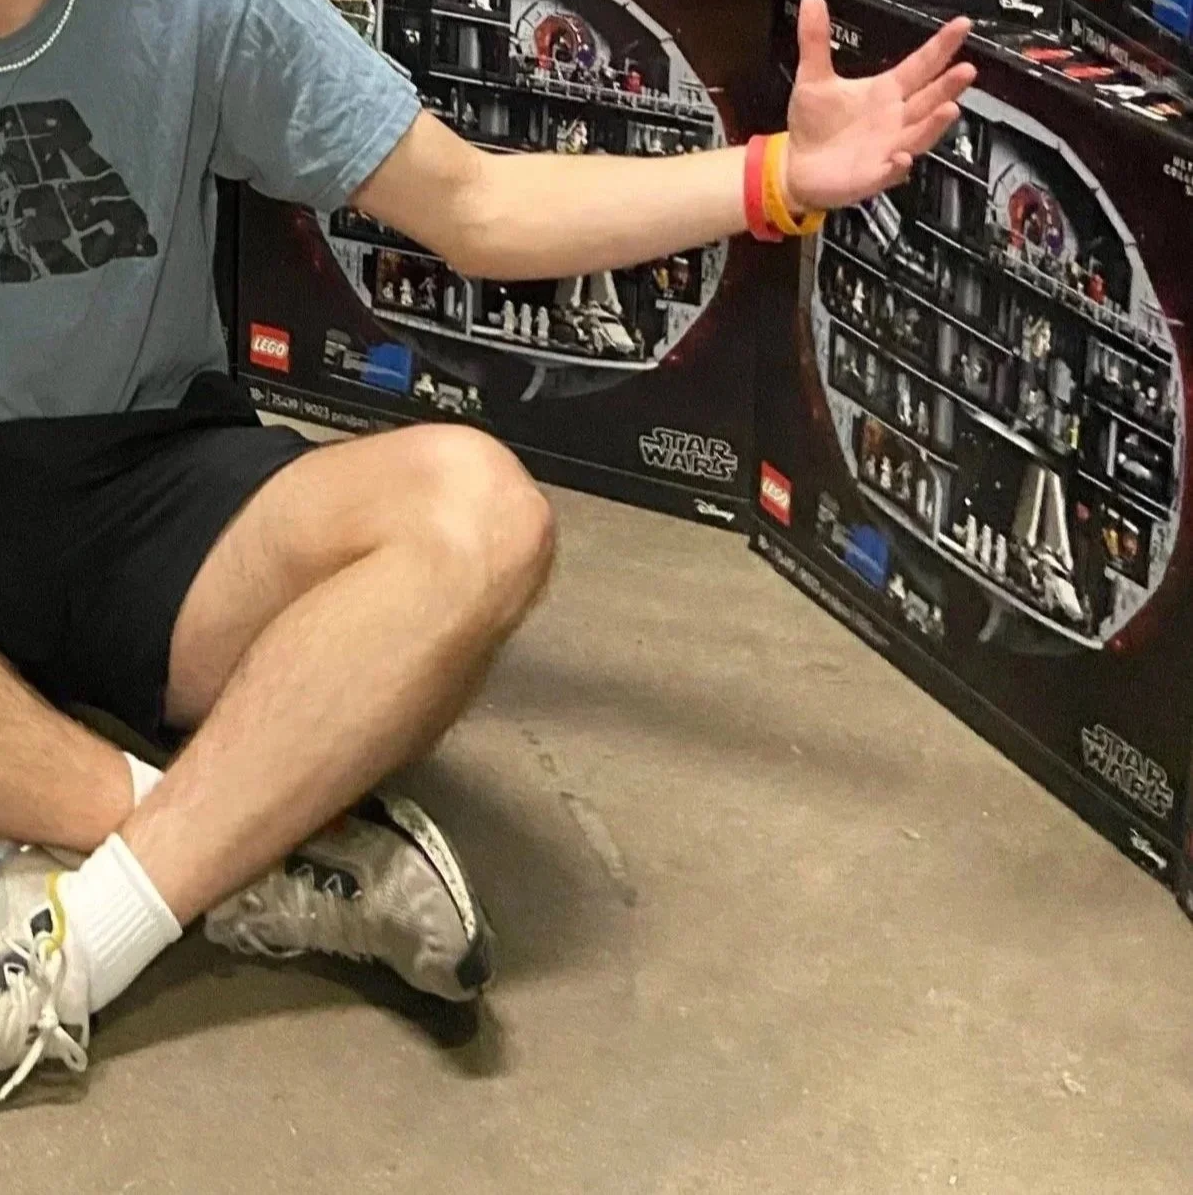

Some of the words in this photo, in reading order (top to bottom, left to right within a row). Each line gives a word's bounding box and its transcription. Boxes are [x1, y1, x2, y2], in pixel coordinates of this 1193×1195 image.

[252, 336, 289, 359] LEGO
[639, 427, 738, 463] STAR
[641, 445, 738, 482] WARS
